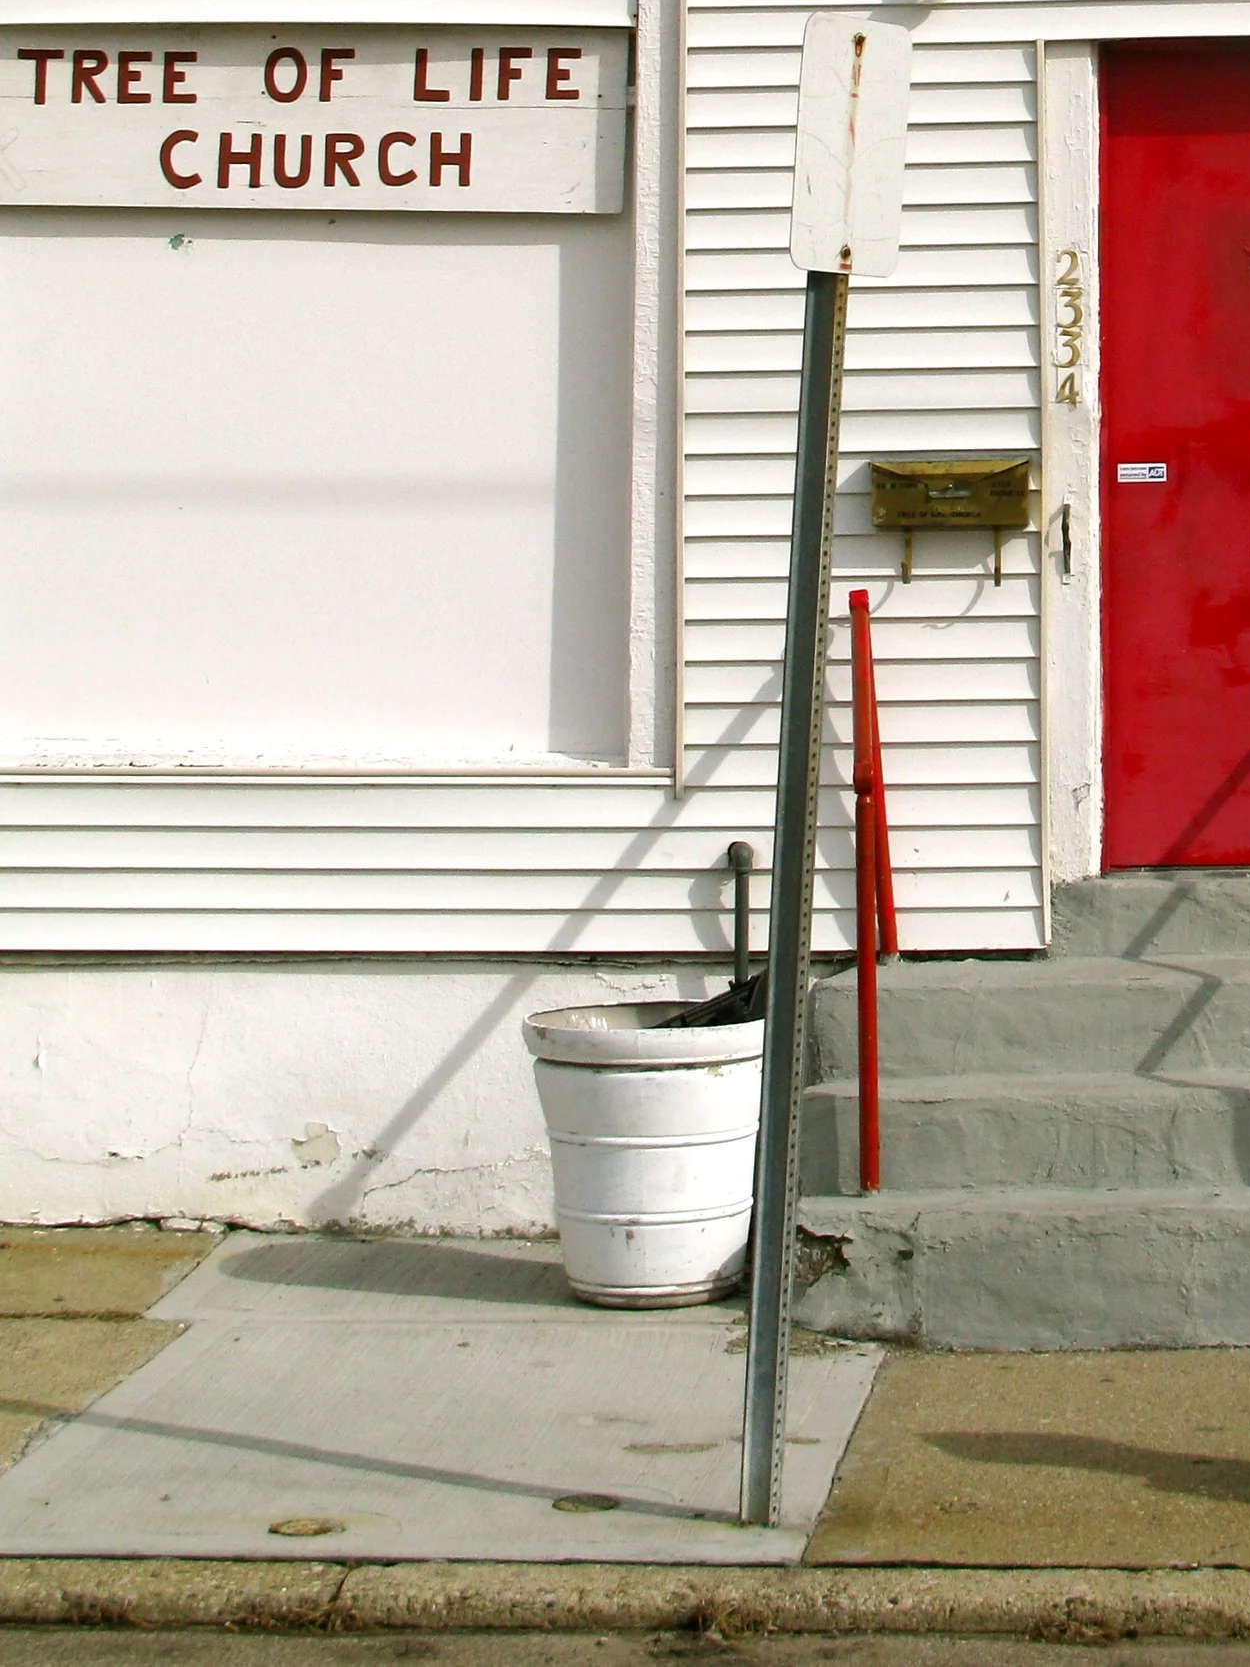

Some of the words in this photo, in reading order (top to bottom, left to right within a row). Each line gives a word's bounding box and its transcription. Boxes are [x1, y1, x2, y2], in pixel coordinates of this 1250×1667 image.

[17, 47, 198, 105] TREE
[263, 46, 356, 103] OF
[412, 46, 583, 102] LIFE
[159, 129, 473, 190] CHURCH
[1056, 248, 1083, 408] 2334
[1148, 467, 1165, 478] ADT
